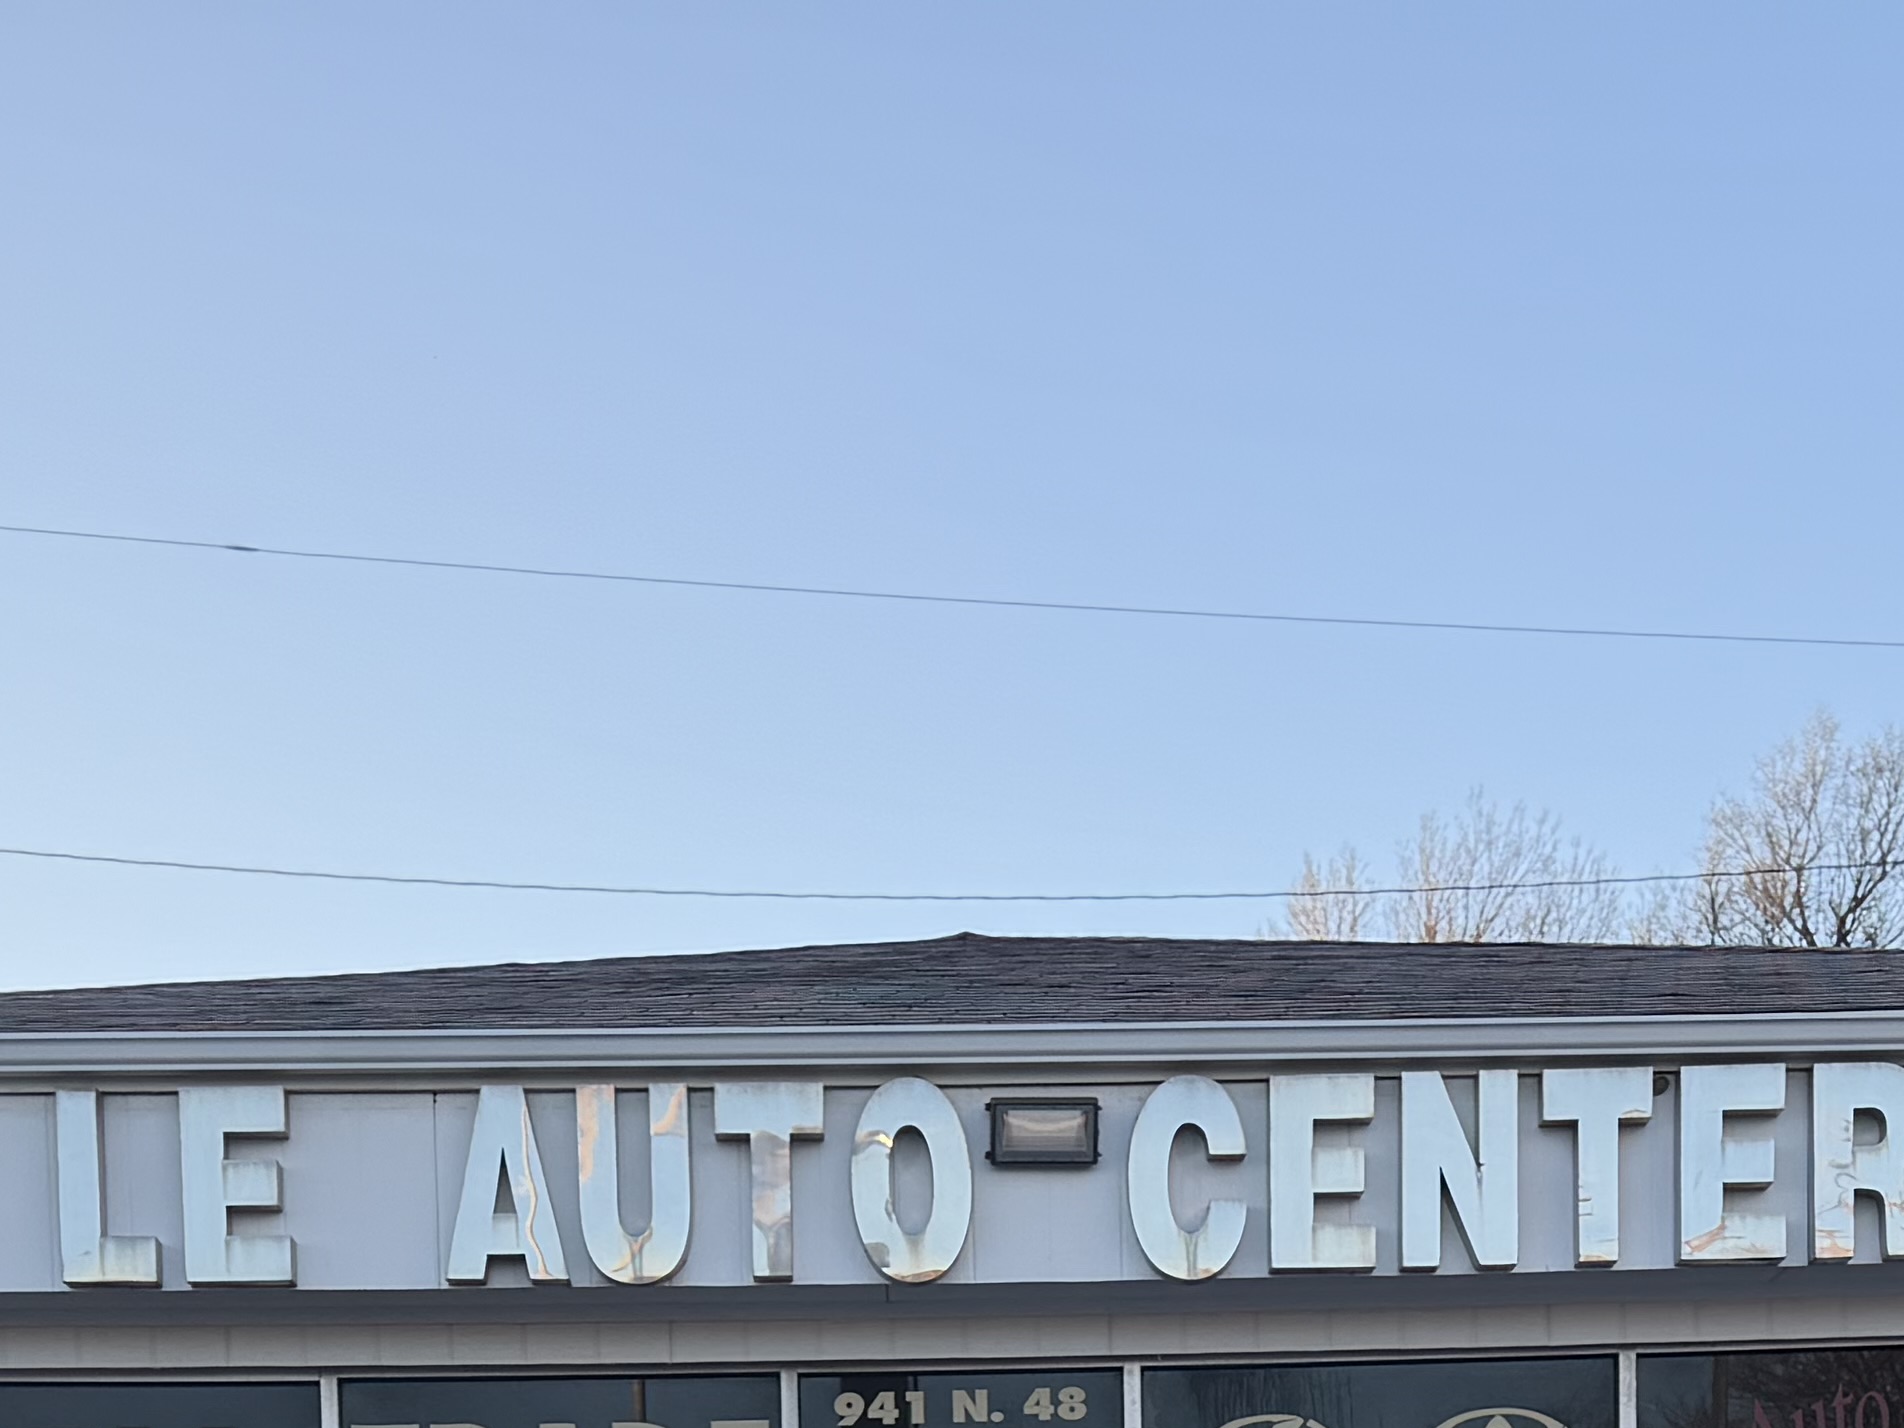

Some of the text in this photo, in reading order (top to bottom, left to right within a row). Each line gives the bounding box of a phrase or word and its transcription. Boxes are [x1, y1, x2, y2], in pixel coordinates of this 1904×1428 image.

[54, 1085, 297, 1288] LE
[444, 1076, 973, 1286] AUTO
[833, 1386, 1087, 1426] 941 N. 48
